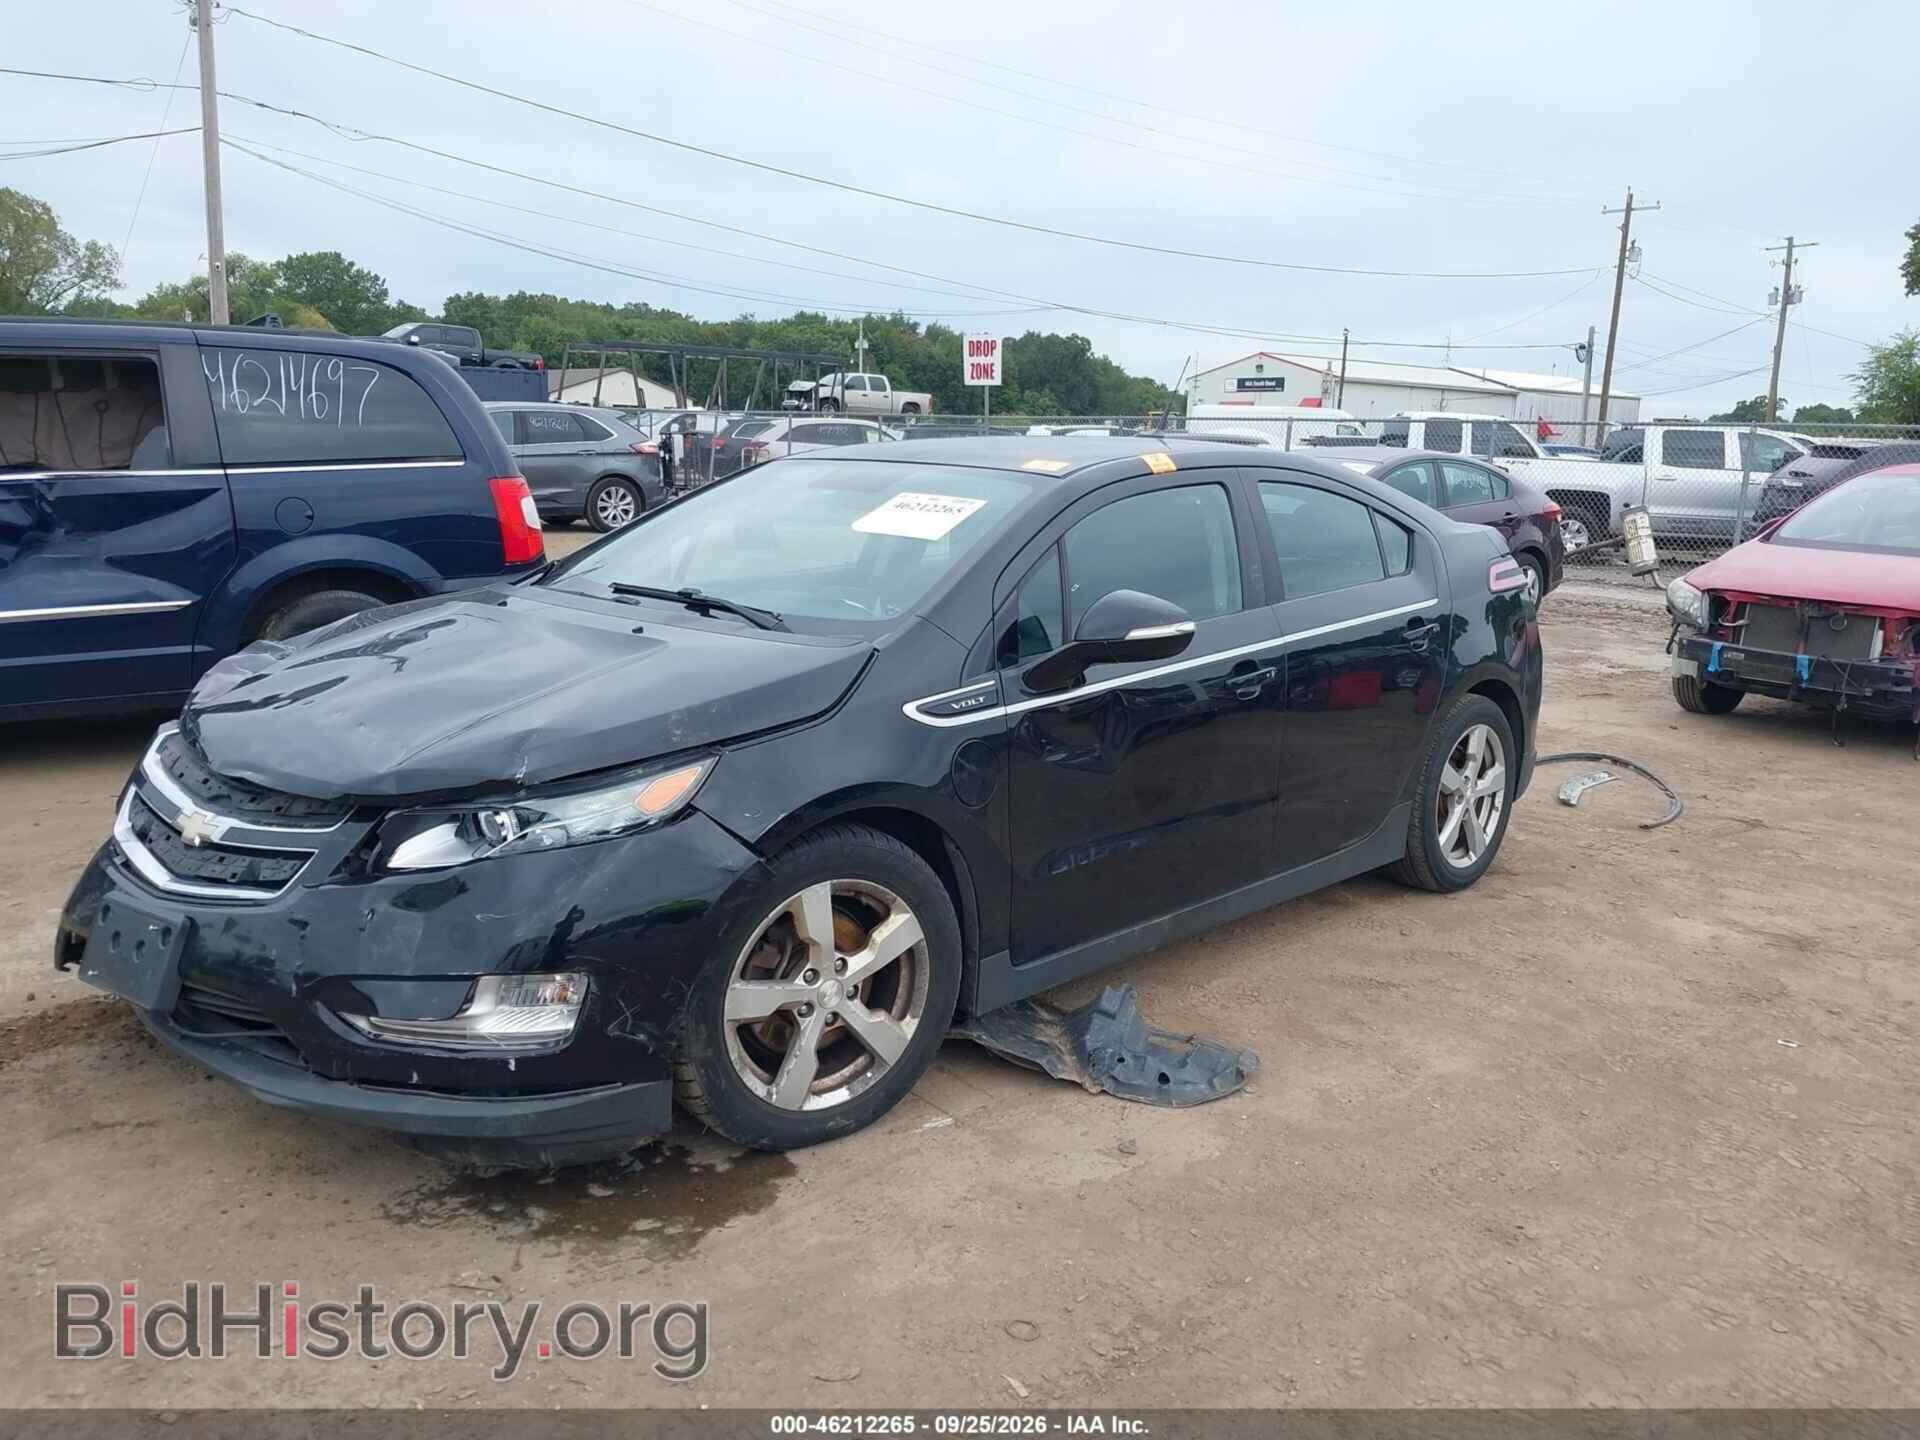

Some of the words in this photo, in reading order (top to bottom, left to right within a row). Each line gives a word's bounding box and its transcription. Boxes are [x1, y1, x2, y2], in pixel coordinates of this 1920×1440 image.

[968, 339, 997, 358] DROP
[970, 362, 996, 380] ZONE
[201, 351, 380, 429] 46214697
[950, 696, 986, 709] VOLT
